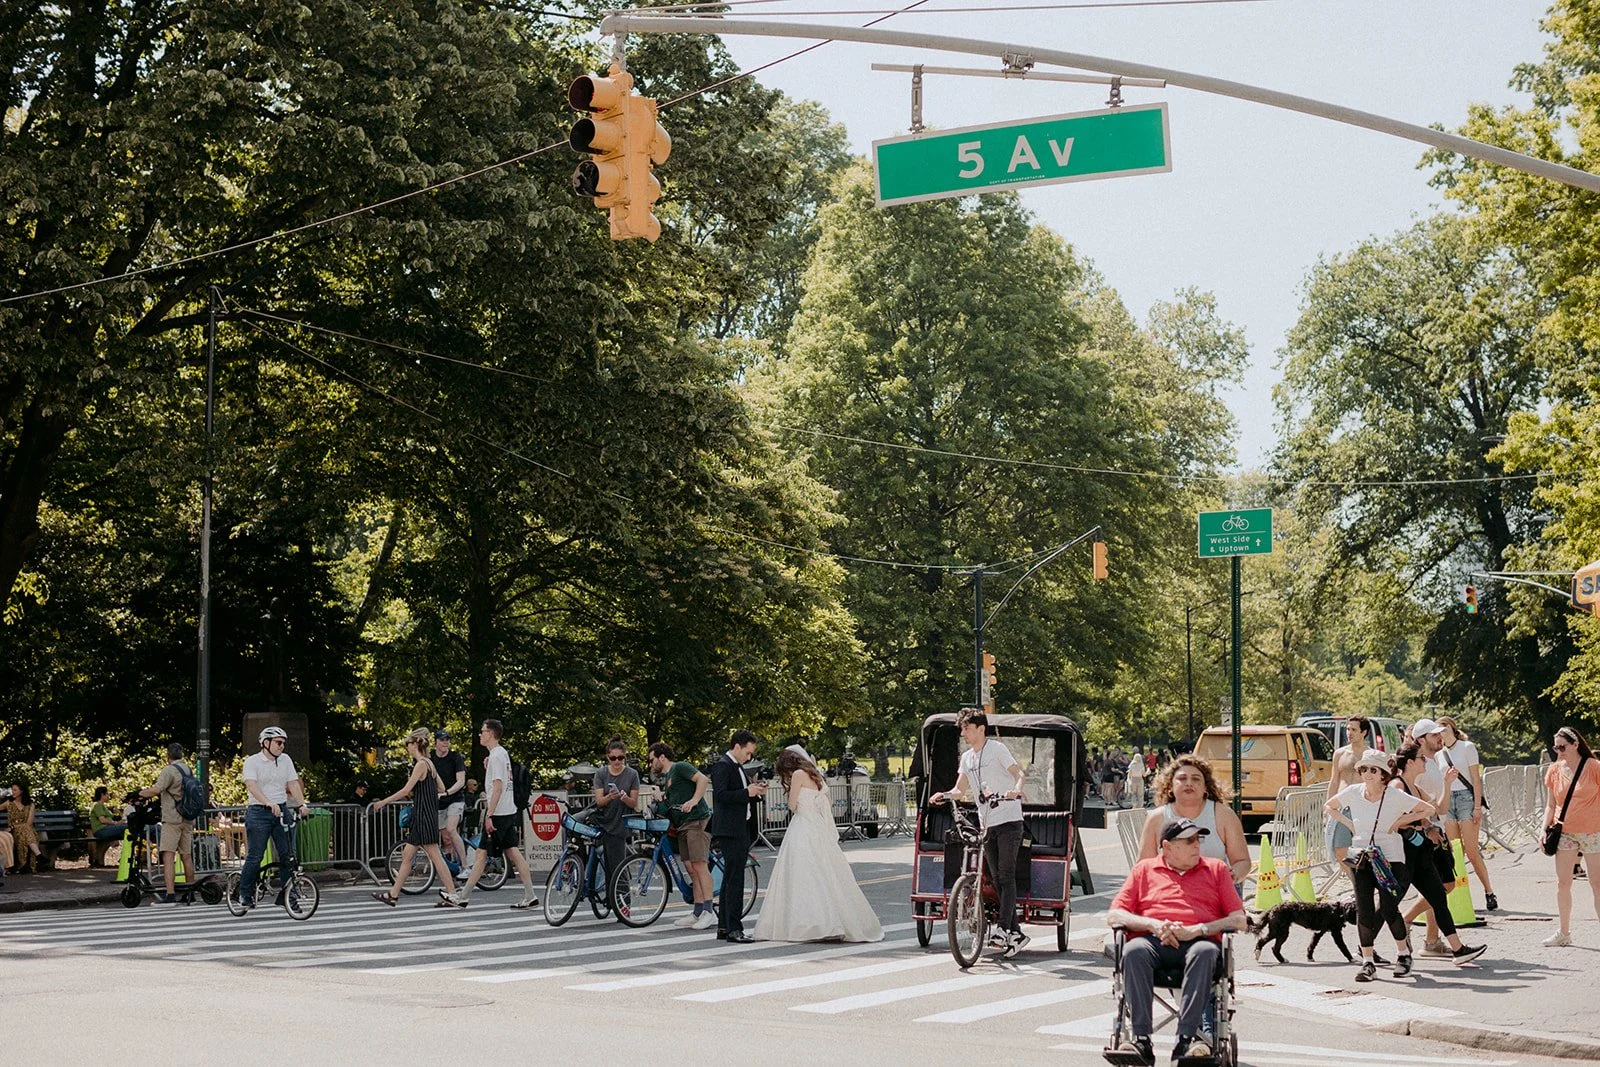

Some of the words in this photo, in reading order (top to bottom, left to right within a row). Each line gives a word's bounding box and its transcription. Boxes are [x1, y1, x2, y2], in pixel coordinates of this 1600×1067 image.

[958, 141, 985, 178] 5
[1007, 135, 1074, 173] Av
[1219, 545, 1249, 554] Uptown
[534, 804, 542, 812] DO
[545, 804, 556, 812] NOT
[538, 824, 555, 832] ENTER
[532, 844, 562, 852] AUTHORIZED
